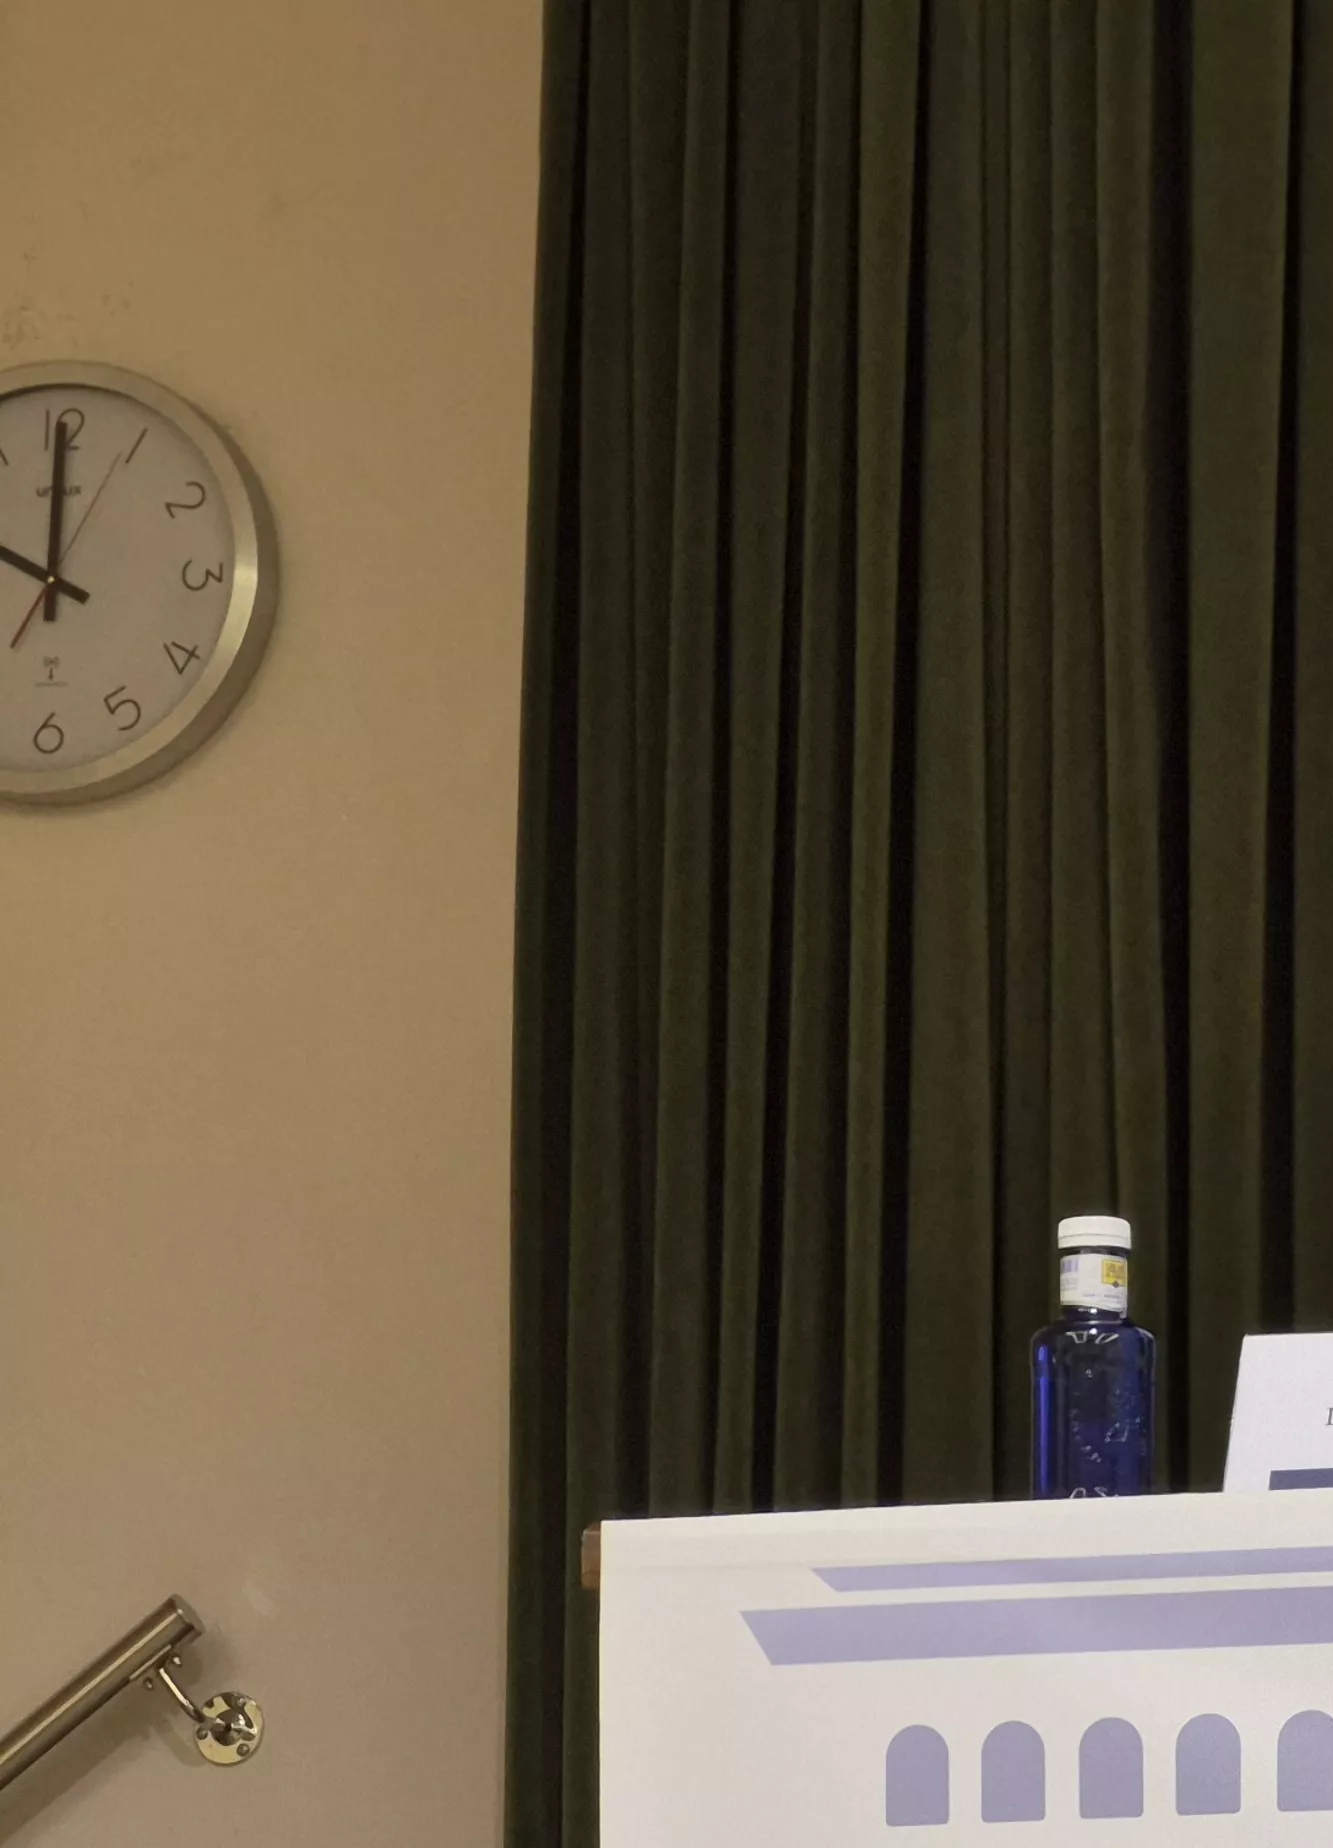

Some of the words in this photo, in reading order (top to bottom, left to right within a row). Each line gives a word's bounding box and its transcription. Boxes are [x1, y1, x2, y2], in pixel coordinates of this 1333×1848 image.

[165, 481, 206, 518] 2
[181, 558, 224, 592] 3
[163, 640, 201, 675] 4
[103, 686, 142, 731] 5
[33, 712, 65, 755] 6
